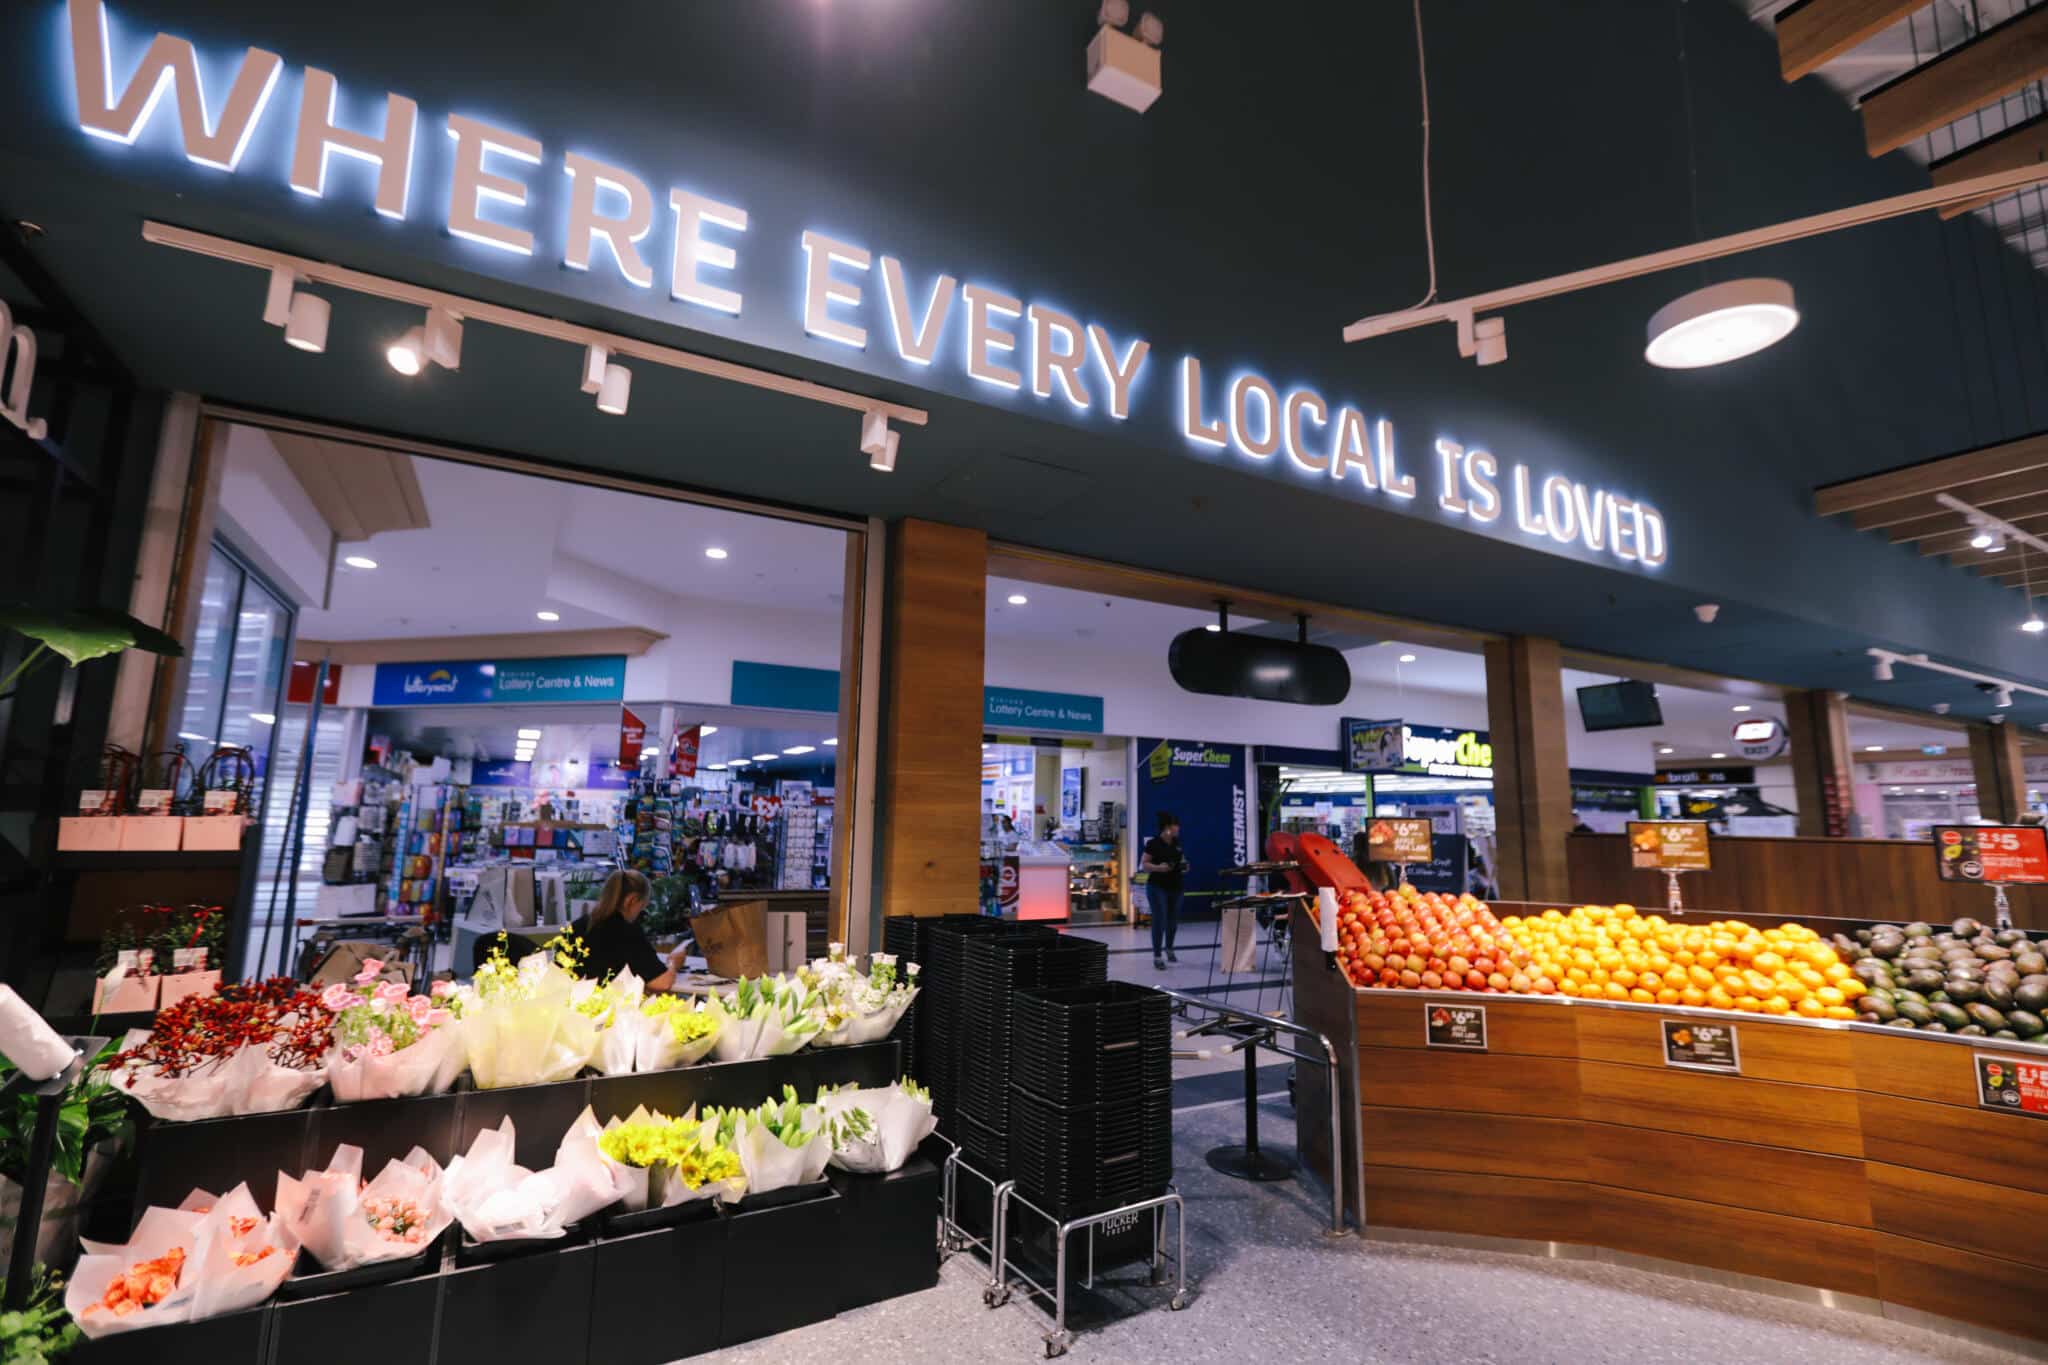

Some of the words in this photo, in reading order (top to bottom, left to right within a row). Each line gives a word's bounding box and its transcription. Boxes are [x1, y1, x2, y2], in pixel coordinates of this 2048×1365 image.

[66, 0, 748, 316] WHERE
[801, 230, 1150, 420] EVERY
[1181, 356, 1416, 500] LOCAL
[1436, 438, 1499, 522] IS
[1515, 463, 1667, 567] LOVED
[499, 677, 534, 691] Lottery
[536, 676, 571, 689] Centre
[573, 675, 581, 687] &
[584, 675, 615, 687] News
[989, 703, 1023, 717] Lottery
[1024, 705, 1056, 719] Centre
[1058, 708, 1065, 719] &
[1067, 710, 1093, 721] News
[1173, 747, 1232, 764] SuperChem
[1402, 726, 1493, 768] SuperChe
[1232, 784, 1246, 867] CHEMIST
[1992, 833, 2020, 851] $5
[1101, 1210, 1139, 1234] TUCKER
